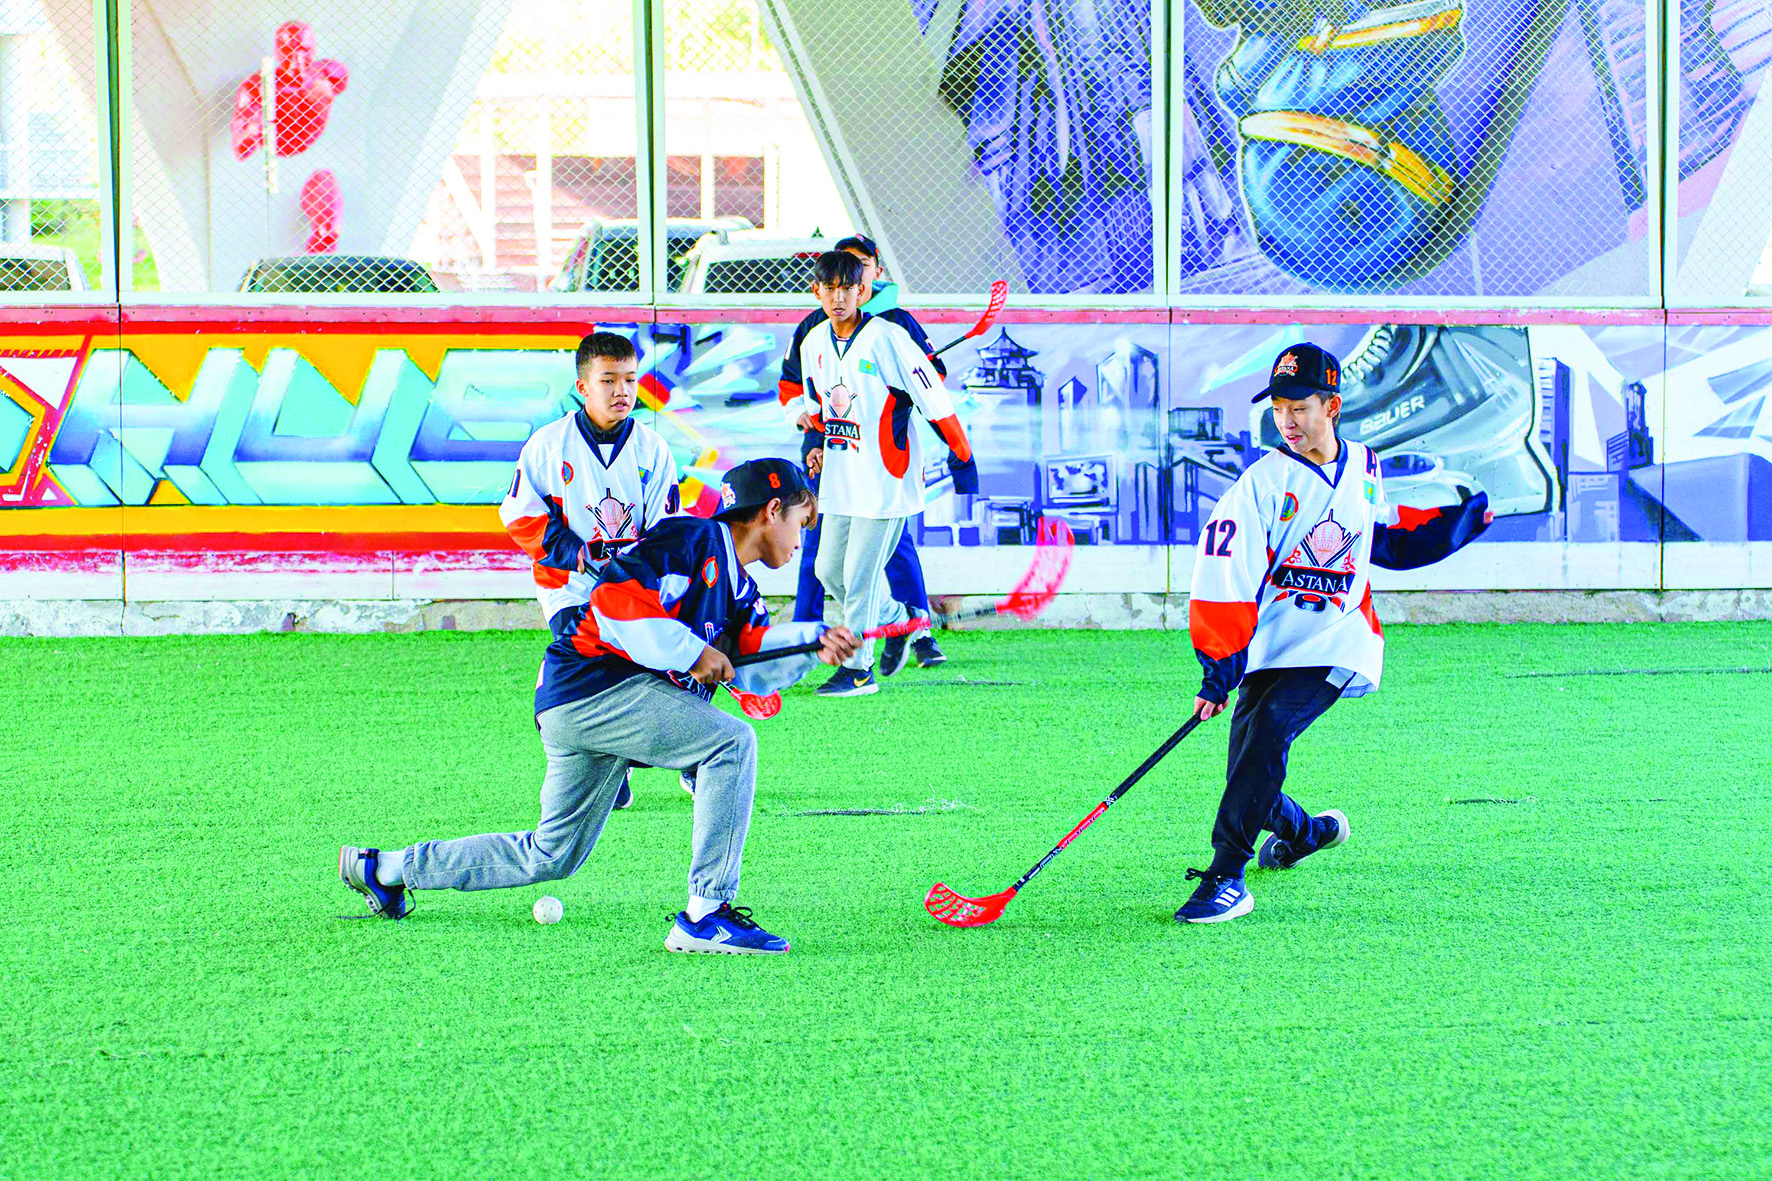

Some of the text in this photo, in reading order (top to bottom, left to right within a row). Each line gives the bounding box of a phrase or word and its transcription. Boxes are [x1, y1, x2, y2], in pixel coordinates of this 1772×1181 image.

[912, 366, 933, 389] 11
[1325, 368, 1338, 386] 12
[1360, 395, 1427, 435] BAUER
[825, 423, 859, 438] STANA
[768, 472, 781, 489] 8
[1205, 519, 1237, 557] 12
[1281, 570, 1349, 593] ASTANA
